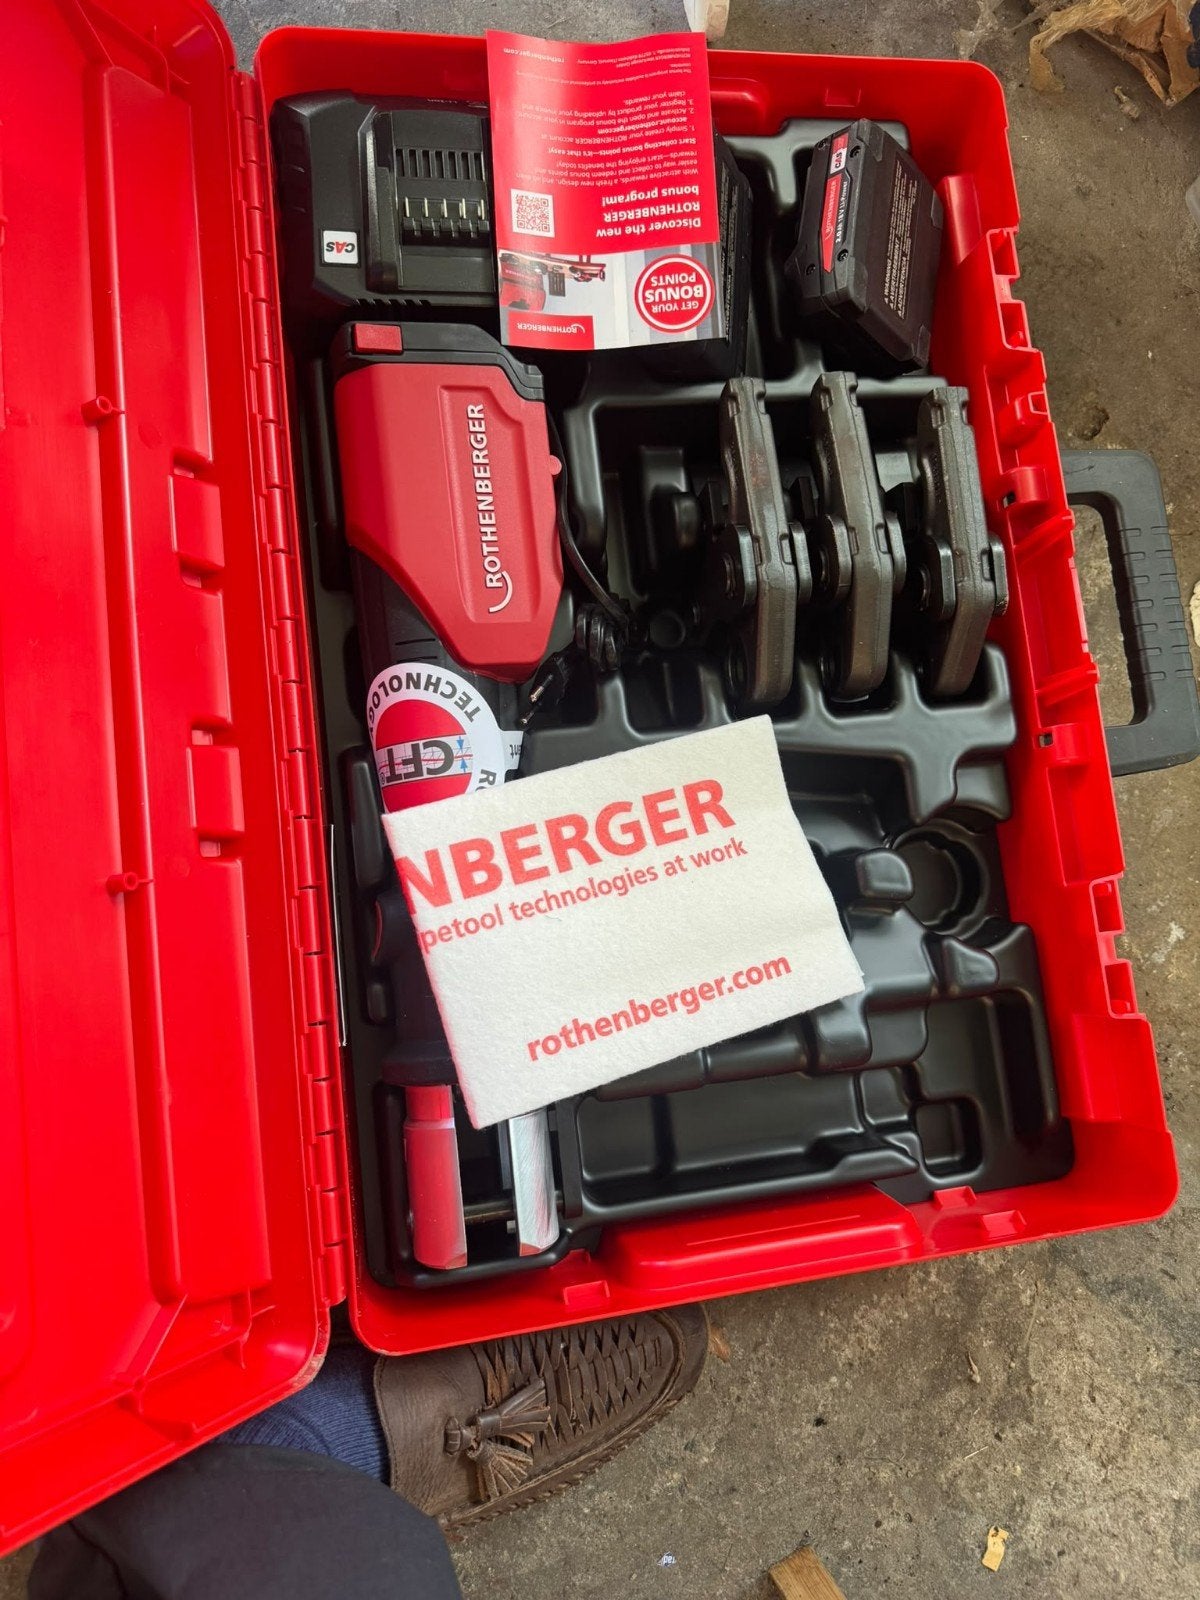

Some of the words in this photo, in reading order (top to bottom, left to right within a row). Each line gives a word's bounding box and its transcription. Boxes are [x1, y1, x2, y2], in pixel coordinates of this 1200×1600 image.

[504, 48, 564, 63] rothenberger.com
[651, 91, 667, 100] your
[643, 102, 659, 110] your
[660, 99, 687, 107] Register
[617, 105, 642, 116] product
[644, 128, 665, 136] create
[666, 125, 688, 133] Simply
[575, 134, 627, 144] ROTHENBERGER
[644, 140, 677, 149] collecting
[622, 145, 643, 153] bonus
[618, 157, 647, 166] enjoying
[650, 170, 681, 178] attractive
[602, 186, 658, 207] program!
[661, 185, 699, 197] bonus
[603, 201, 700, 222] ROTHENBERGER
[826, 180, 836, 234] ROTHENBERGER
[625, 224, 646, 235] the
[649, 218, 701, 232] Discover
[596, 228, 622, 237] new
[325, 241, 355, 254] CAS
[651, 272, 696, 286] POINTS
[644, 284, 704, 303] BONUS
[651, 303, 679, 313] YOUR
[681, 301, 699, 310] GET
[517, 322, 578, 334] ROTHENBERGER
[467, 404, 503, 588] ROTHENBERGER
[394, 779, 736, 915] NBERGER
[419, 904, 503, 955] petool
[509, 862, 658, 920] technologies
[663, 854, 688, 876] at
[690, 837, 748, 870] work
[527, 955, 792, 1061] rothenberger.com
